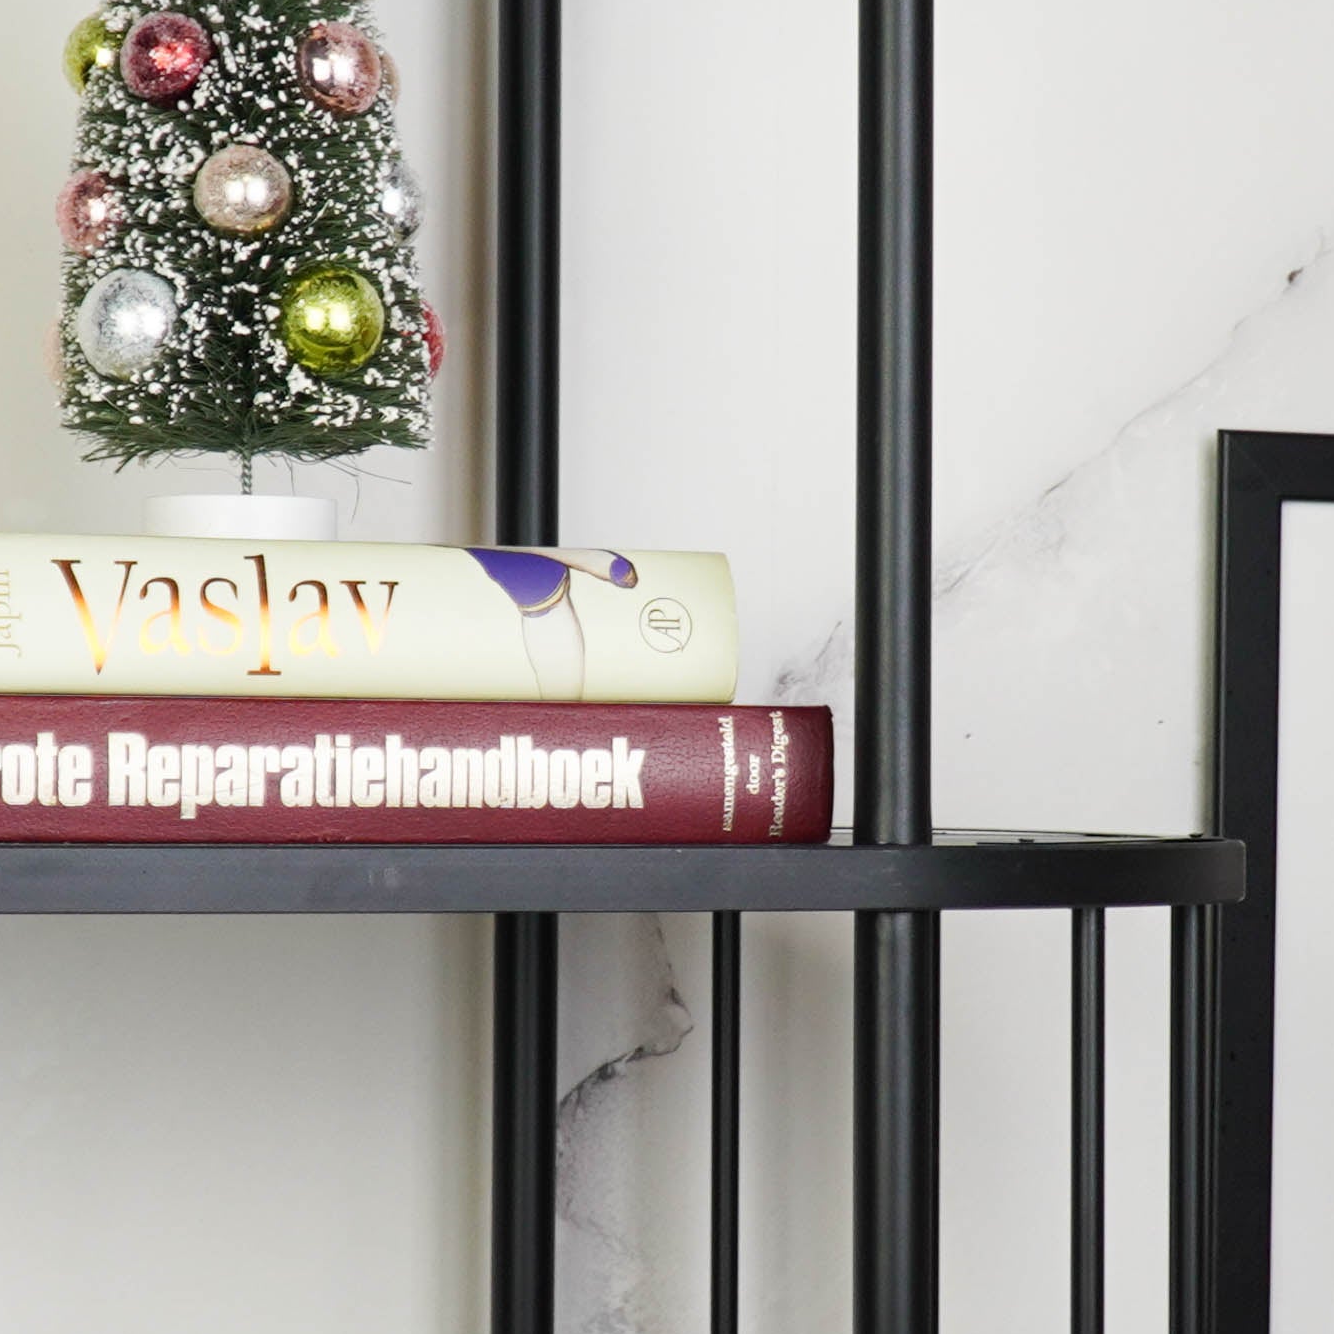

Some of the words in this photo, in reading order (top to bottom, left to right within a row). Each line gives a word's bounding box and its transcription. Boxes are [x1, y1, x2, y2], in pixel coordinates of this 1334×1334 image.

[50, 553, 399, 676] Vaslav
[107, 731, 646, 820] Reparatiehandboek
[718, 715, 739, 831] samengesteld
[746, 753, 761, 794] door
[769, 710, 789, 764] Digest
[769, 768, 788, 837] Reader's
